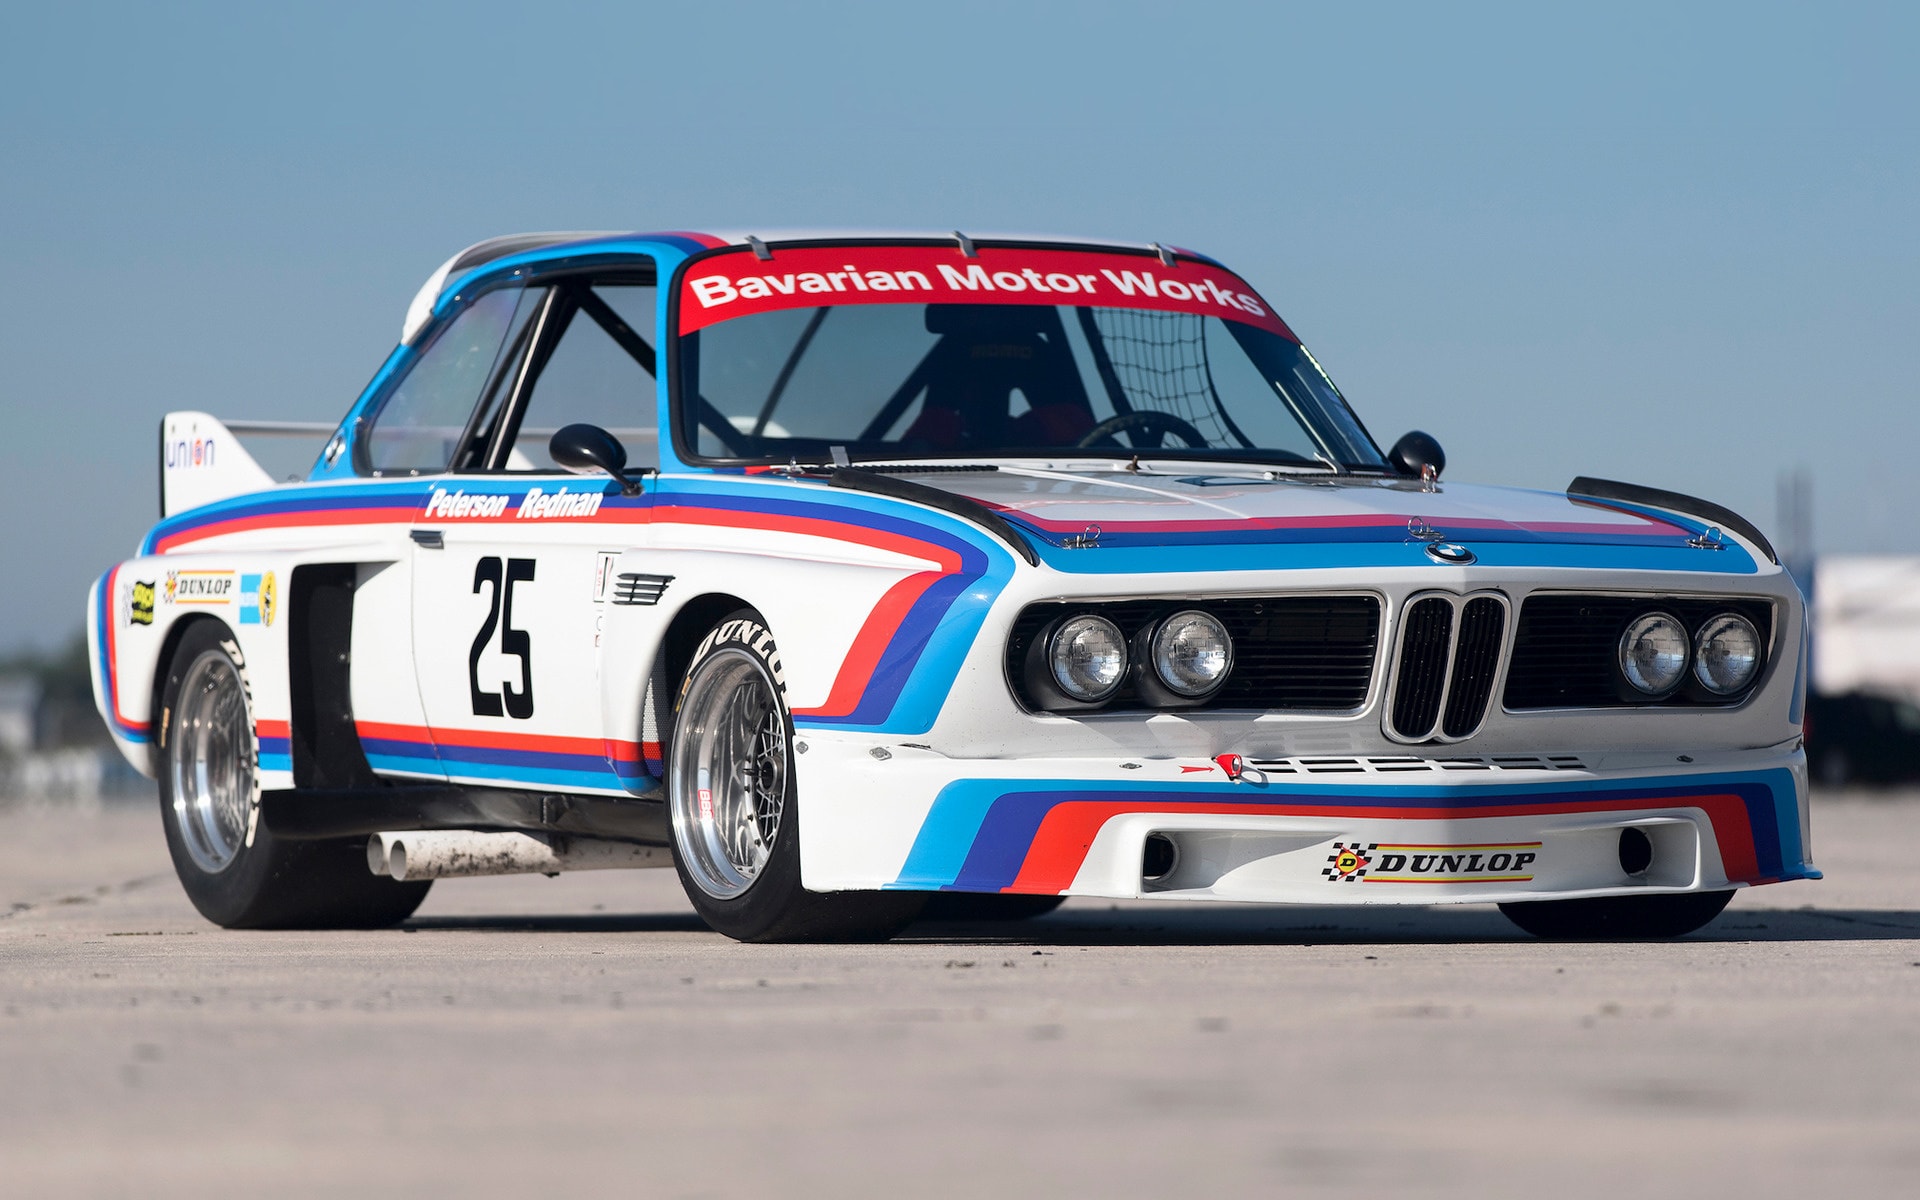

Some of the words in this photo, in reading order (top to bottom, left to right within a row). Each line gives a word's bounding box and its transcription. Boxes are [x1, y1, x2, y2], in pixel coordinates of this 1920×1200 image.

[689, 264, 934, 309] Bavarian
[936, 263, 1098, 293] Motor
[1100, 268, 1267, 318] Works
[424, 487, 510, 519] Peterson
[516, 486, 604, 519] Redman
[179, 579, 232, 595] DUNLOP
[468, 555, 537, 720] 25
[1374, 852, 1537, 873] DUNLOP
